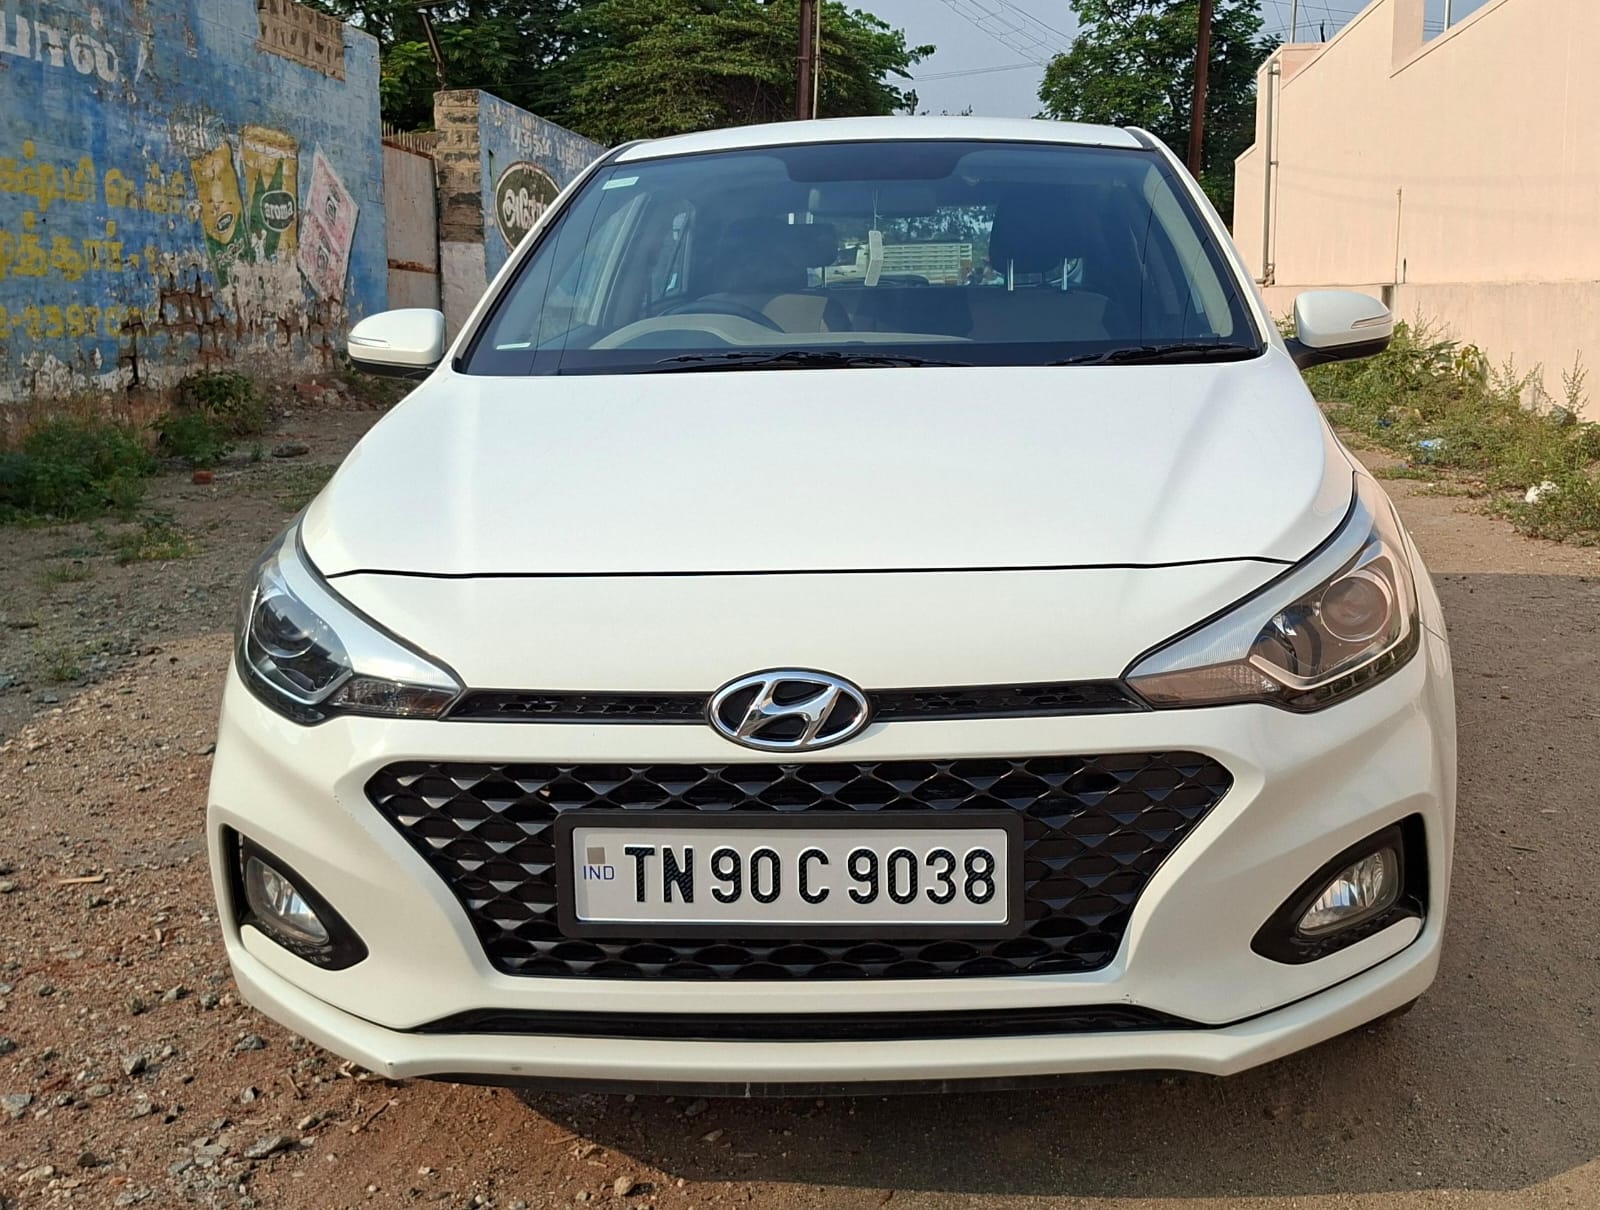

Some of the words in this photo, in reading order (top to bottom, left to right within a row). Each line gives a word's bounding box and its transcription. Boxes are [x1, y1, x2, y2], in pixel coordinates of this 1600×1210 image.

[264, 200, 293, 220] aroma
[583, 864, 615, 881] IND
[624, 845, 694, 904] TN
[711, 846, 781, 905] 90
[798, 846, 830, 905] C
[847, 846, 996, 905] 9038
